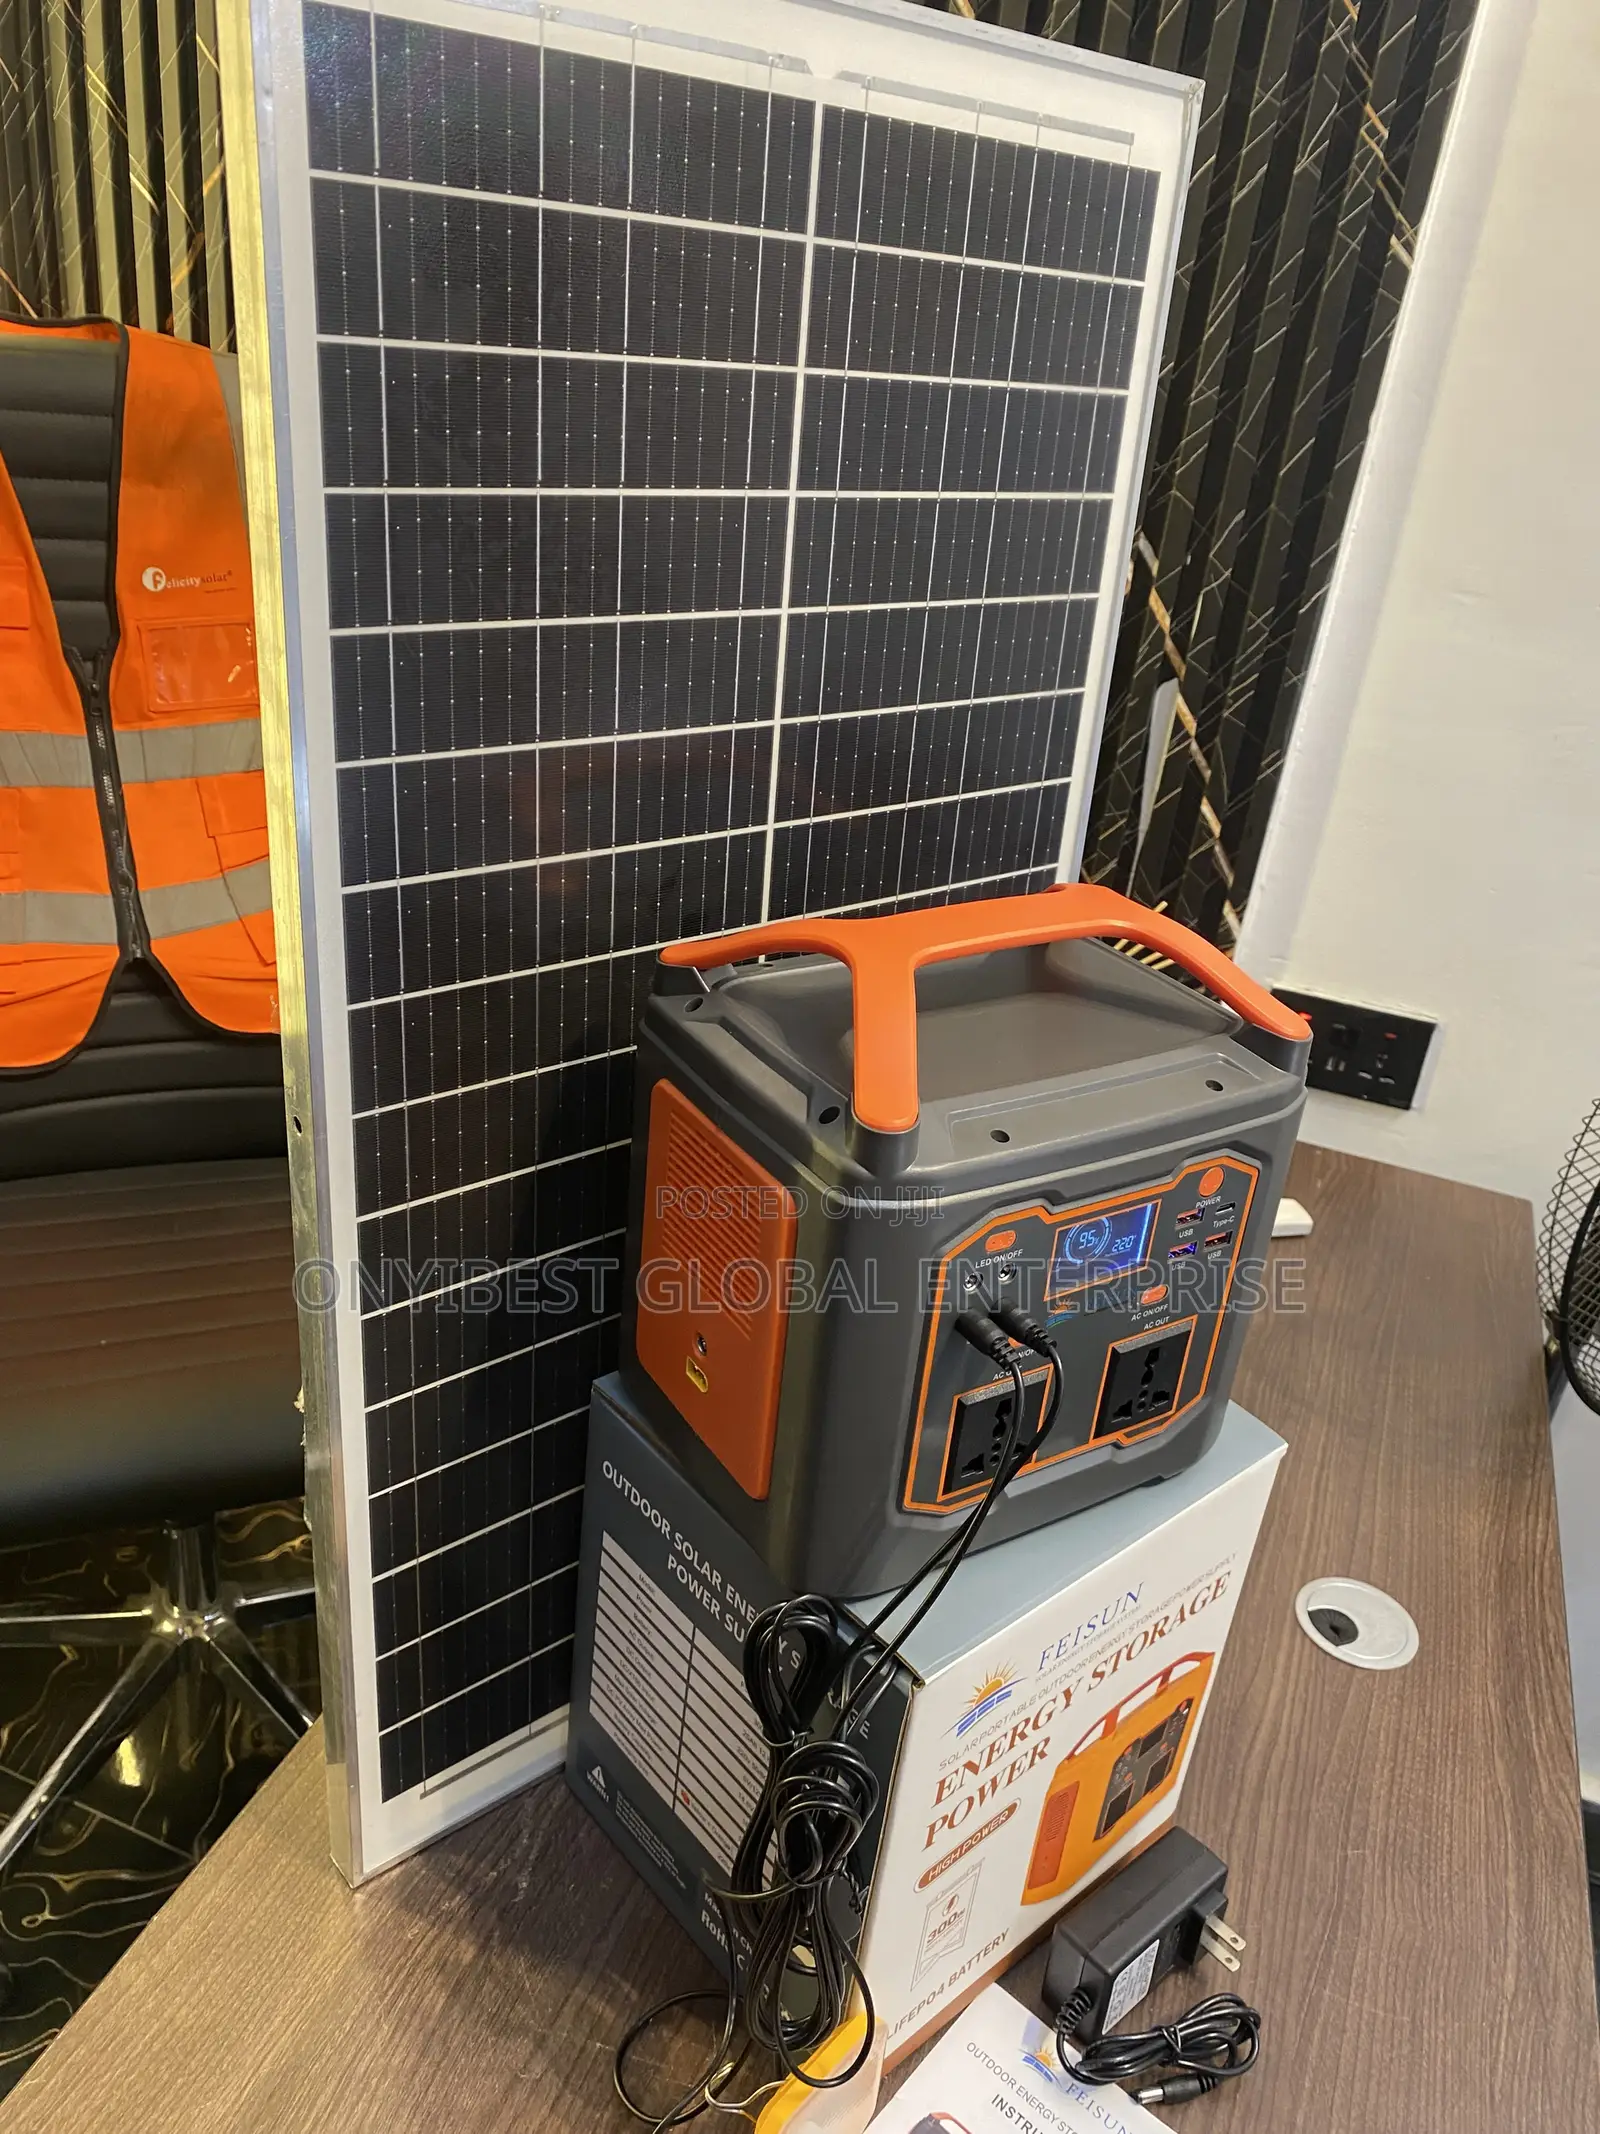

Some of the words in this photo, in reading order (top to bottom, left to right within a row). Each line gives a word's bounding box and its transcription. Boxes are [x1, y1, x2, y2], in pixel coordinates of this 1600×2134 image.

[1195, 1196, 1222, 1208] POWER
[1178, 1229, 1194, 1239] USB
[1213, 1216, 1235, 1228] Type-C
[975, 1258, 992, 1269] LED
[993, 1249, 1024, 1264] ON/OFF
[1171, 1261, 1186, 1271] USB
[1207, 1250, 1222, 1260] USB
[1131, 1312, 1144, 1322] AC
[1144, 1304, 1169, 1318] ON/OFF
[1143, 1322, 1154, 1331] AC
[1154, 1316, 1171, 1327] OUT
[602, 1460, 671, 1540] OUTDOOR
[673, 1532, 722, 1592] SOLAR
[667, 1553, 720, 1621] POWER
[1037, 1581, 1145, 1673] FEISUN
[931, 1677, 1083, 1808] ENERGY
[1087, 1570, 1231, 1693] STORAGE
[922, 1736, 1051, 1851] POWER
[928, 1846, 962, 1882] HIGH
[961, 1809, 1010, 1854] POWER
[948, 1928, 1010, 1987] BATTERY
[966, 2042, 1017, 2093] OUTDOOR
[1015, 2085, 1061, 2127] ENERGY
